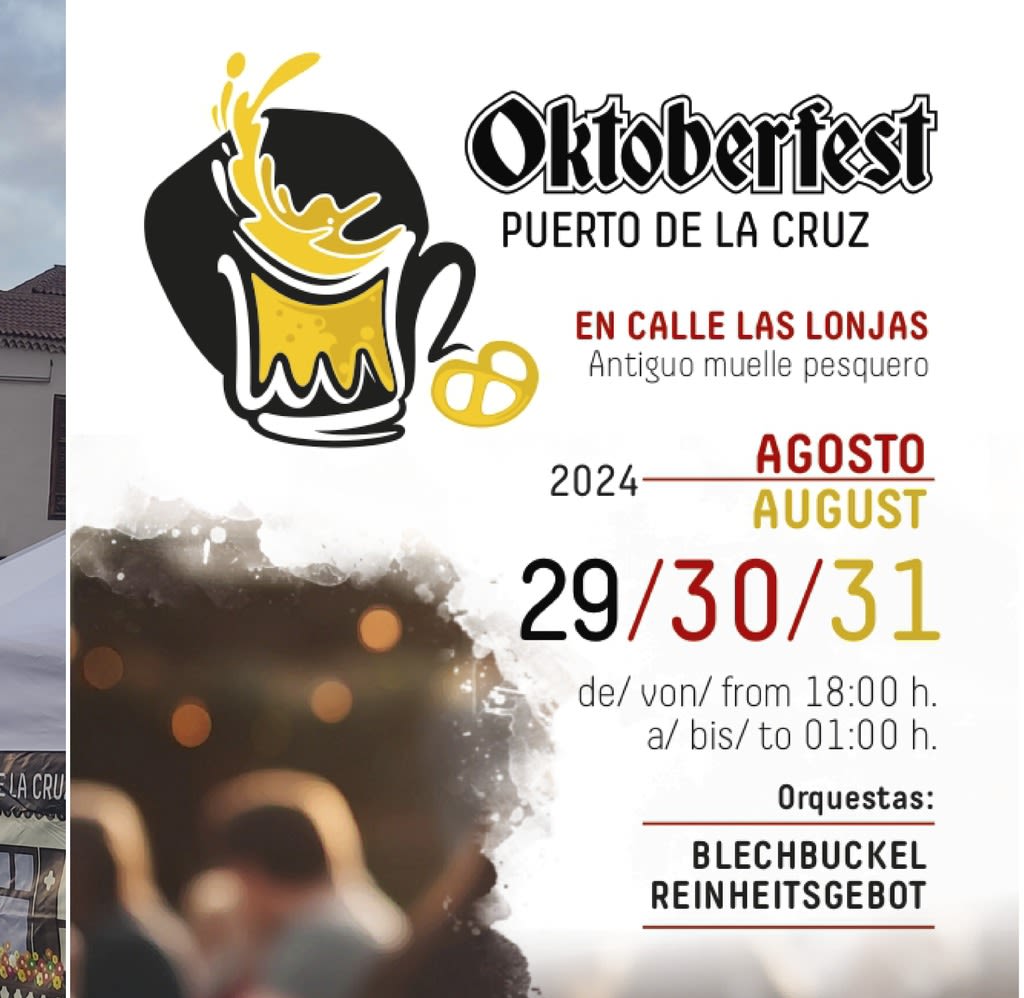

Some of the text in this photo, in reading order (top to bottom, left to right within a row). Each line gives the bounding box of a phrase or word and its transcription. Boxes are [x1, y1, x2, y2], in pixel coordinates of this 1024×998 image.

[465, 91, 938, 195] Oktoberfest
[501, 211, 870, 249] PUERTO DE LA CRUZ
[576, 310, 930, 341] EN CALLE LAS LONJAS
[588, 350, 930, 385] Antiguo muelle pesquero
[755, 433, 926, 475] AGOSTO
[550, 464, 639, 498] 2024
[753, 489, 927, 530] AUGUST
[578, 675, 938, 707] de/ von/ from 18:00 h.
[647, 718, 938, 751] a/ bis/ to 01:00 h.
[9, 773, 27, 799] LA
[32, 773, 66, 800] CRU
[777, 784, 935, 815] Orquestas:
[692, 841, 927, 870] BLECHBUCKEL
[651, 881, 927, 910] REINHEITSGEBOT
